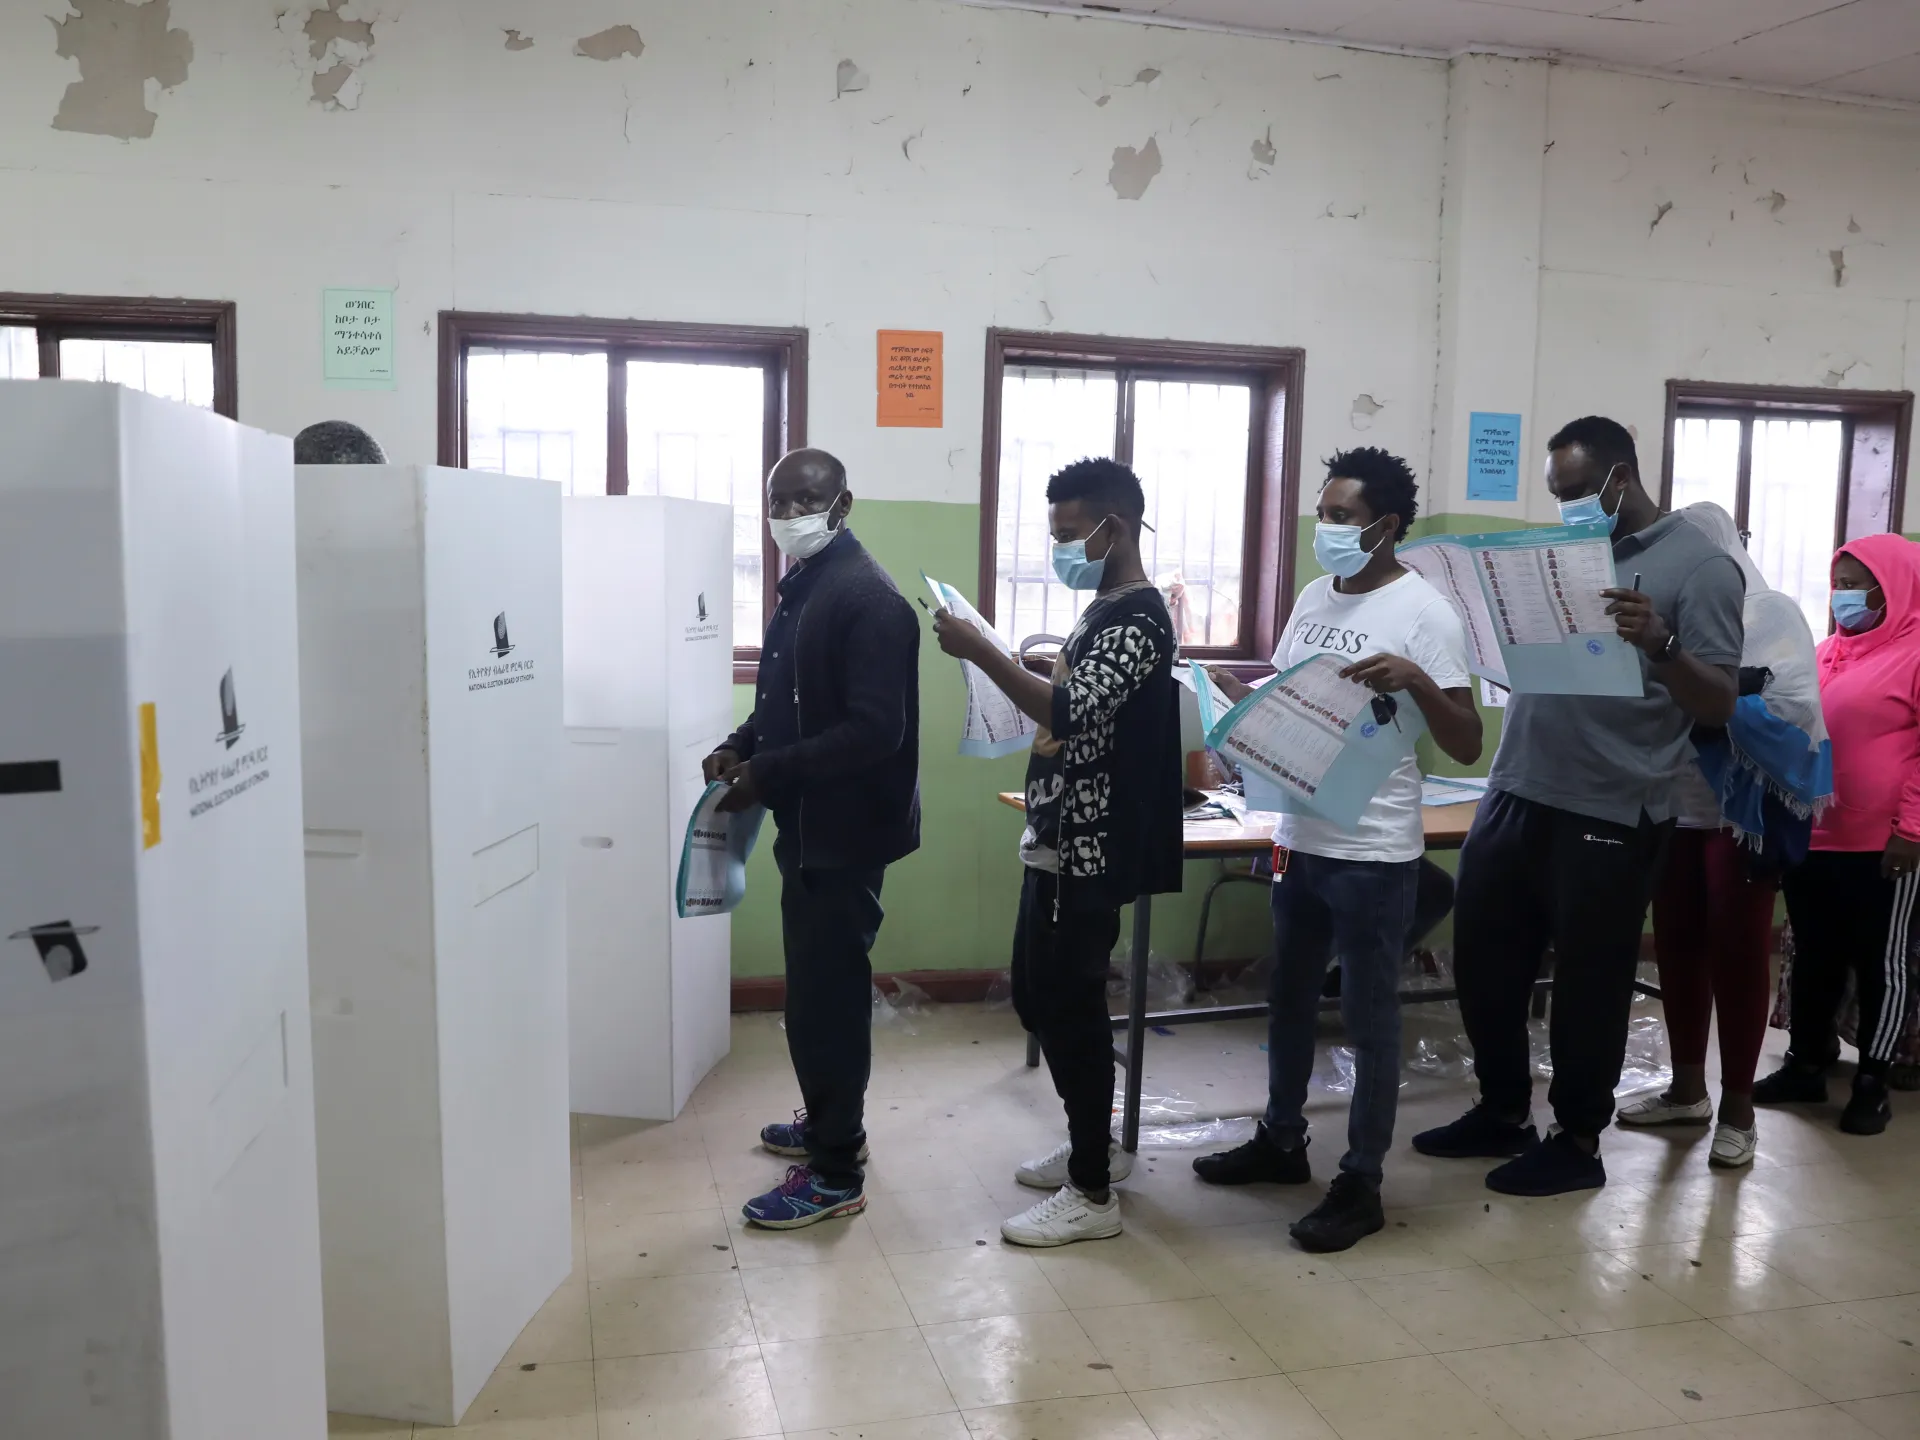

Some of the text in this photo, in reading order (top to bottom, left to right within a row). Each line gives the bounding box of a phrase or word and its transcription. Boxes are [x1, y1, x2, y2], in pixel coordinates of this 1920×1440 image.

[345, 300, 375, 310] ወንበር
[335, 314, 381, 326] ከቦታ ቦታ
[1294, 622, 1369, 654] GUESS
[468, 682, 487, 692] NATIONAL
[487, 679, 503, 689] ELECTION
[503, 677, 515, 686] BOARD
[520, 674, 534, 682] ETHIOPIA
[1067, 1212, 1089, 1224] K-Bird
